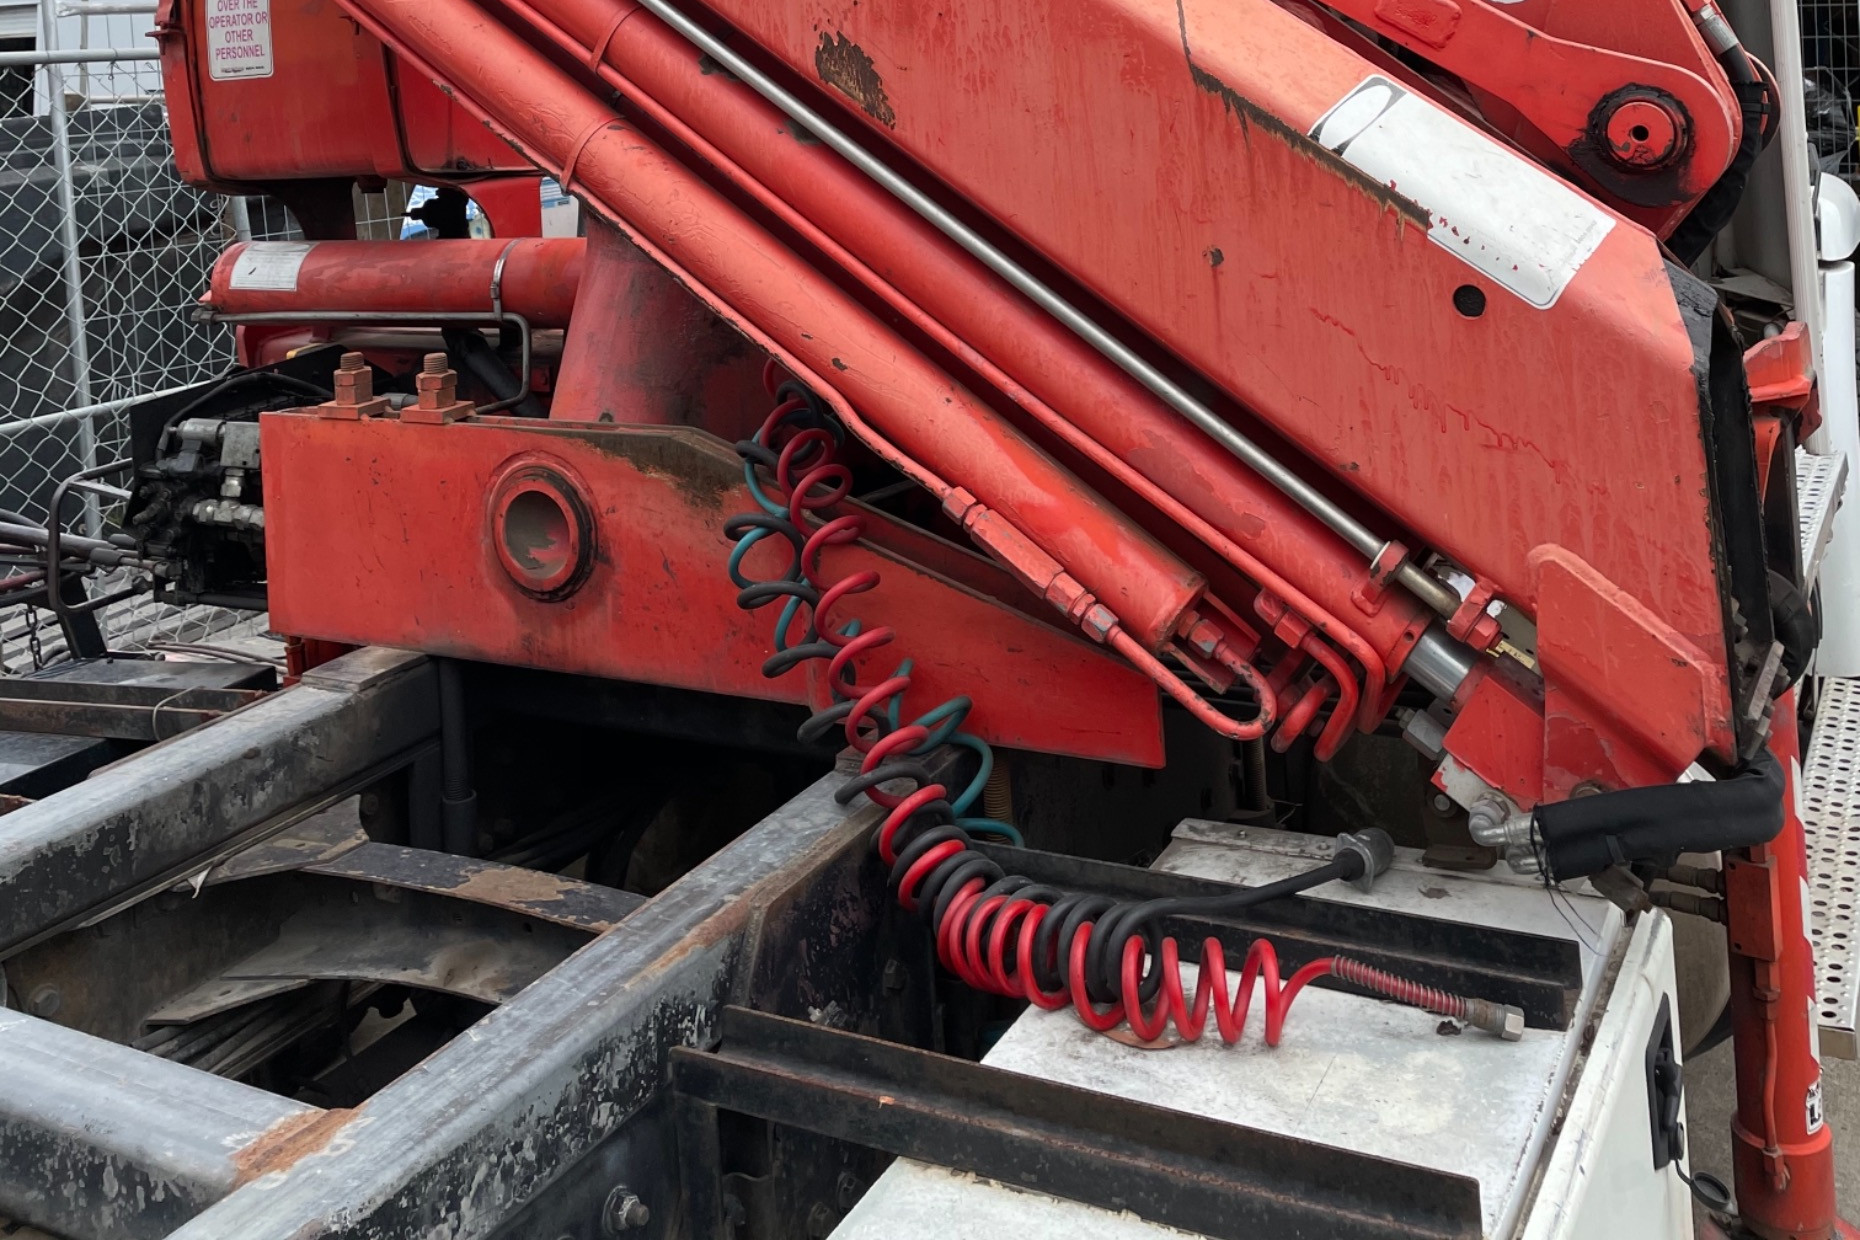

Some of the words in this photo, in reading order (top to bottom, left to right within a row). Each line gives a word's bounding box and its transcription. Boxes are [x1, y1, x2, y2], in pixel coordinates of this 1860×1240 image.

[209, 12, 254, 29] OPERATOR
[255, 11, 268, 25] OR
[224, 29, 253, 44] OTHER
[215, 44, 265, 60] PERSONNEL
